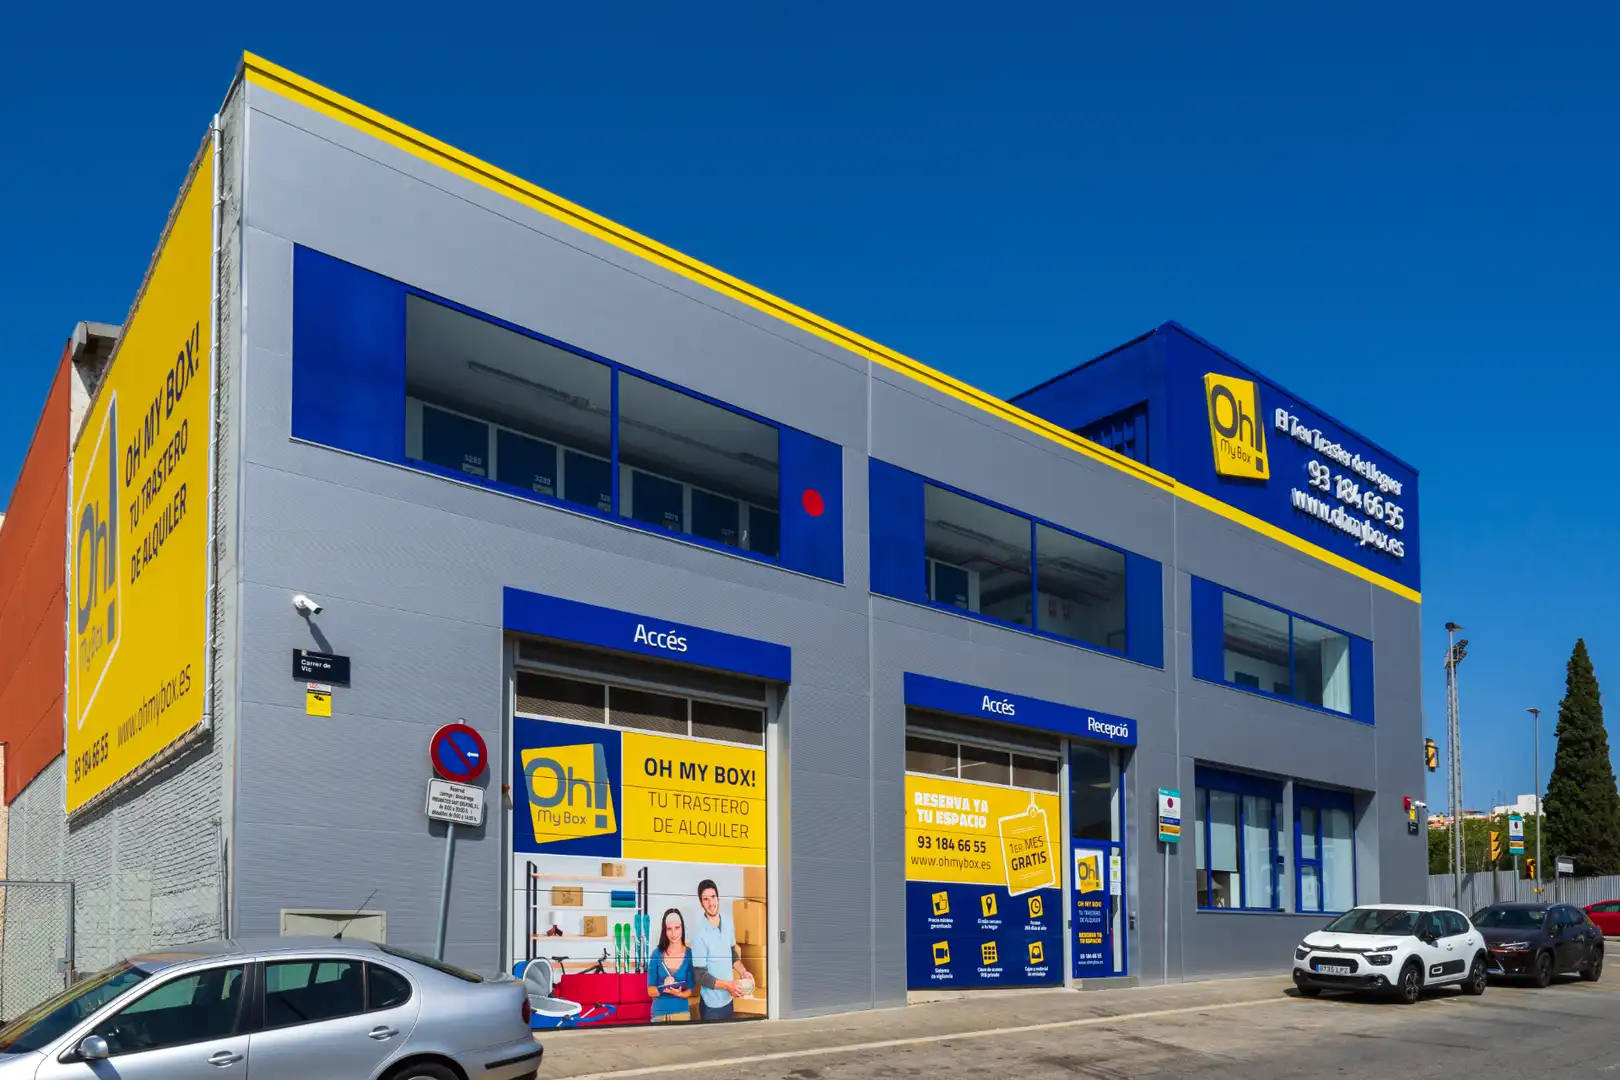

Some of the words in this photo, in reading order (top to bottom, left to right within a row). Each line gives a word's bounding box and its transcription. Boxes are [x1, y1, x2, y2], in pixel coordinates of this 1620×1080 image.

[125, 427, 141, 488] OH
[143, 385, 163, 459] MY
[166, 320, 200, 420] BOX!
[1211, 381, 1264, 473] Oh!
[130, 495, 140, 534] TU
[141, 418, 188, 516] TRASTERO
[1308, 460, 1330, 492] 93
[1333, 474, 1362, 509] 184
[1363, 491, 1384, 520] 66
[1384, 501, 1404, 530] 55
[77, 394, 117, 644] Oh!
[131, 545, 141, 585] DE
[142, 481, 187, 572] ALQUILER
[633, 623, 688, 652] Accés
[301, 659, 322, 668] Carrer
[301, 665, 312, 673] Vic
[117, 663, 191, 748] www.ohmybox.es
[981, 695, 1015, 716] Accés
[1087, 716, 1129, 739] Recepció
[74, 756, 81, 784] 93
[82, 747, 92, 778] 184
[92, 739, 100, 769] 66
[100, 731, 109, 763] 55
[643, 757, 673, 778] OH
[679, 761, 708, 782] MY
[714, 765, 756, 787] BOX!
[524, 743, 608, 829] Oh!
[648, 791, 668, 809] TU
[673, 794, 749, 816] TRASTERO
[914, 792, 970, 811] RESERVA
[973, 799, 989, 813] YA
[563, 810, 587, 825] Box
[653, 817, 674, 834] DE
[678, 819, 749, 840] ALQUILER
[916, 808, 933, 823] TU
[935, 810, 987, 829] ESPACIO
[917, 835, 932, 849] 93
[935, 837, 955, 851] 184
[957, 839, 971, 852] 66
[973, 841, 986, 853] 55
[1024, 835, 1044, 850] MES
[911, 855, 992, 872] www.ohmybox.es
[1011, 851, 1047, 871] GRATIS
